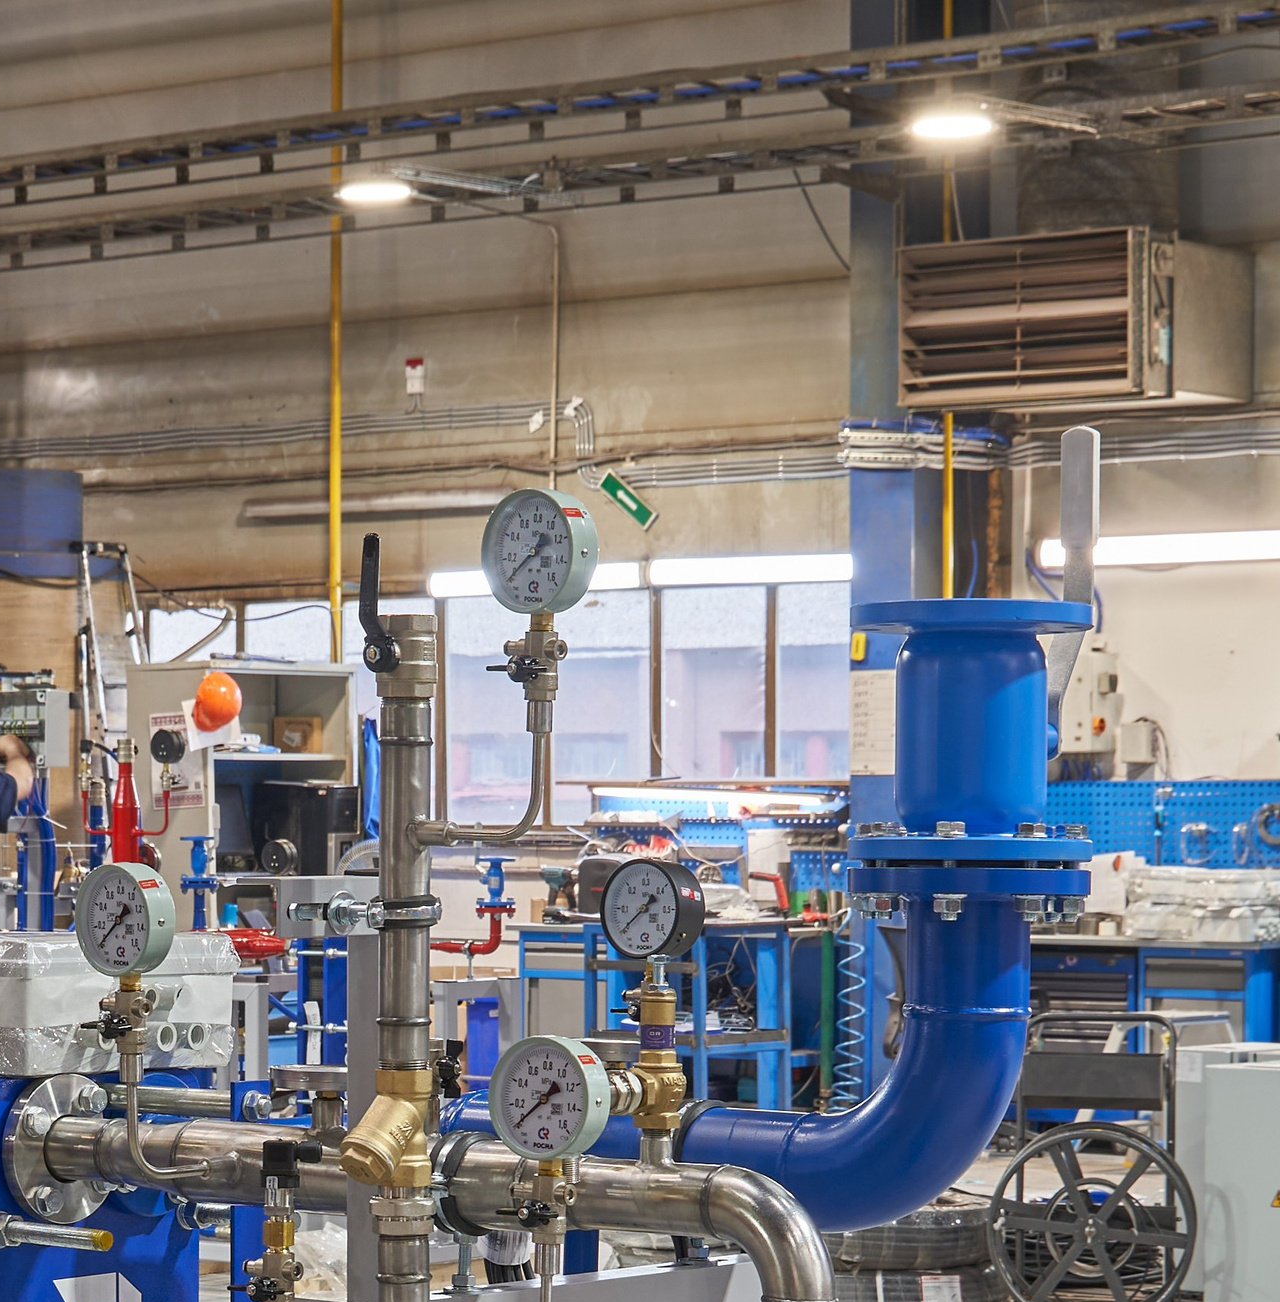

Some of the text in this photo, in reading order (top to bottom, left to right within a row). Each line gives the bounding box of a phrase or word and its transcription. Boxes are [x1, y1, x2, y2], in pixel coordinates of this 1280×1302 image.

[534, 513, 542, 523] 0,8
[520, 519, 529, 529] 0,6
[547, 521, 555, 530] 1,0
[510, 532, 519, 541] 0,4
[554, 535, 562, 544] 1,2
[508, 553, 516, 562] 0,2
[555, 555, 563, 564] 1,4
[547, 573, 555, 582] 1,6
[642, 878, 650, 886] 0,3
[106, 891, 114, 899] 0,6
[628, 886, 636, 895] 0,2
[656, 887, 664, 895] 0,4
[99, 903, 107, 911] 0,4
[543, 1060, 552, 1071] 0,8
[528, 1066, 538, 1076] 0,6
[557, 1069, 567, 1078] 1,0
[518, 1078, 528, 1088] 0,4
[566, 1082, 575, 1092] 1,2
[515, 1098, 525, 1109] 0,2
[567, 1103, 576, 1113] 1,4
[558, 1120, 567, 1130] 1,6
[533, 1142, 554, 1150] РОСМА
